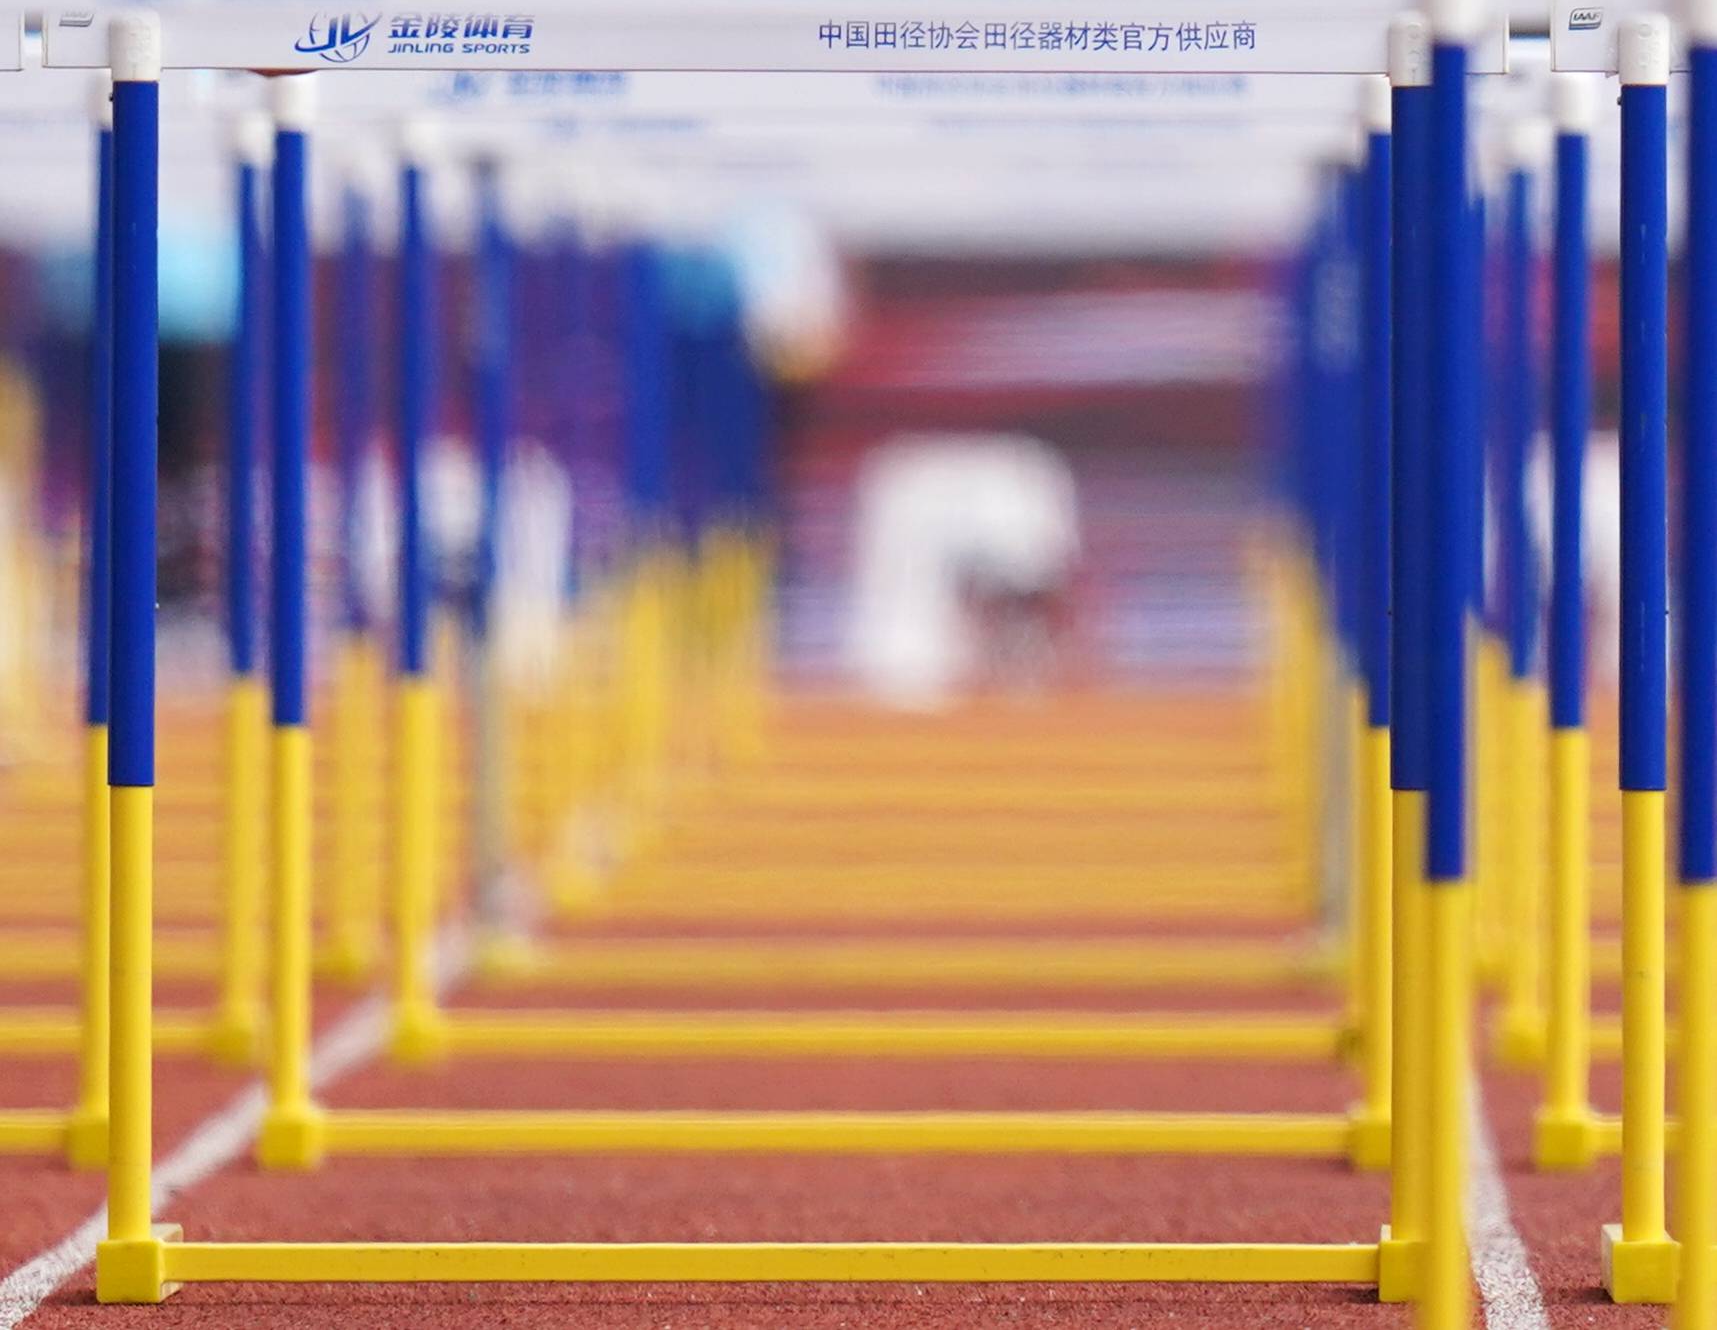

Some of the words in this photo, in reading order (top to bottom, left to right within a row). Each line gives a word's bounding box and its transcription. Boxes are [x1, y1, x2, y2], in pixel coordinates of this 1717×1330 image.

[388, 12, 535, 40] 金陵体育
[818, 19, 1257, 53] 中国田径协会田径器材类官方供应商
[388, 42, 454, 54] JINLING
[462, 42, 531, 54] SPORTS
